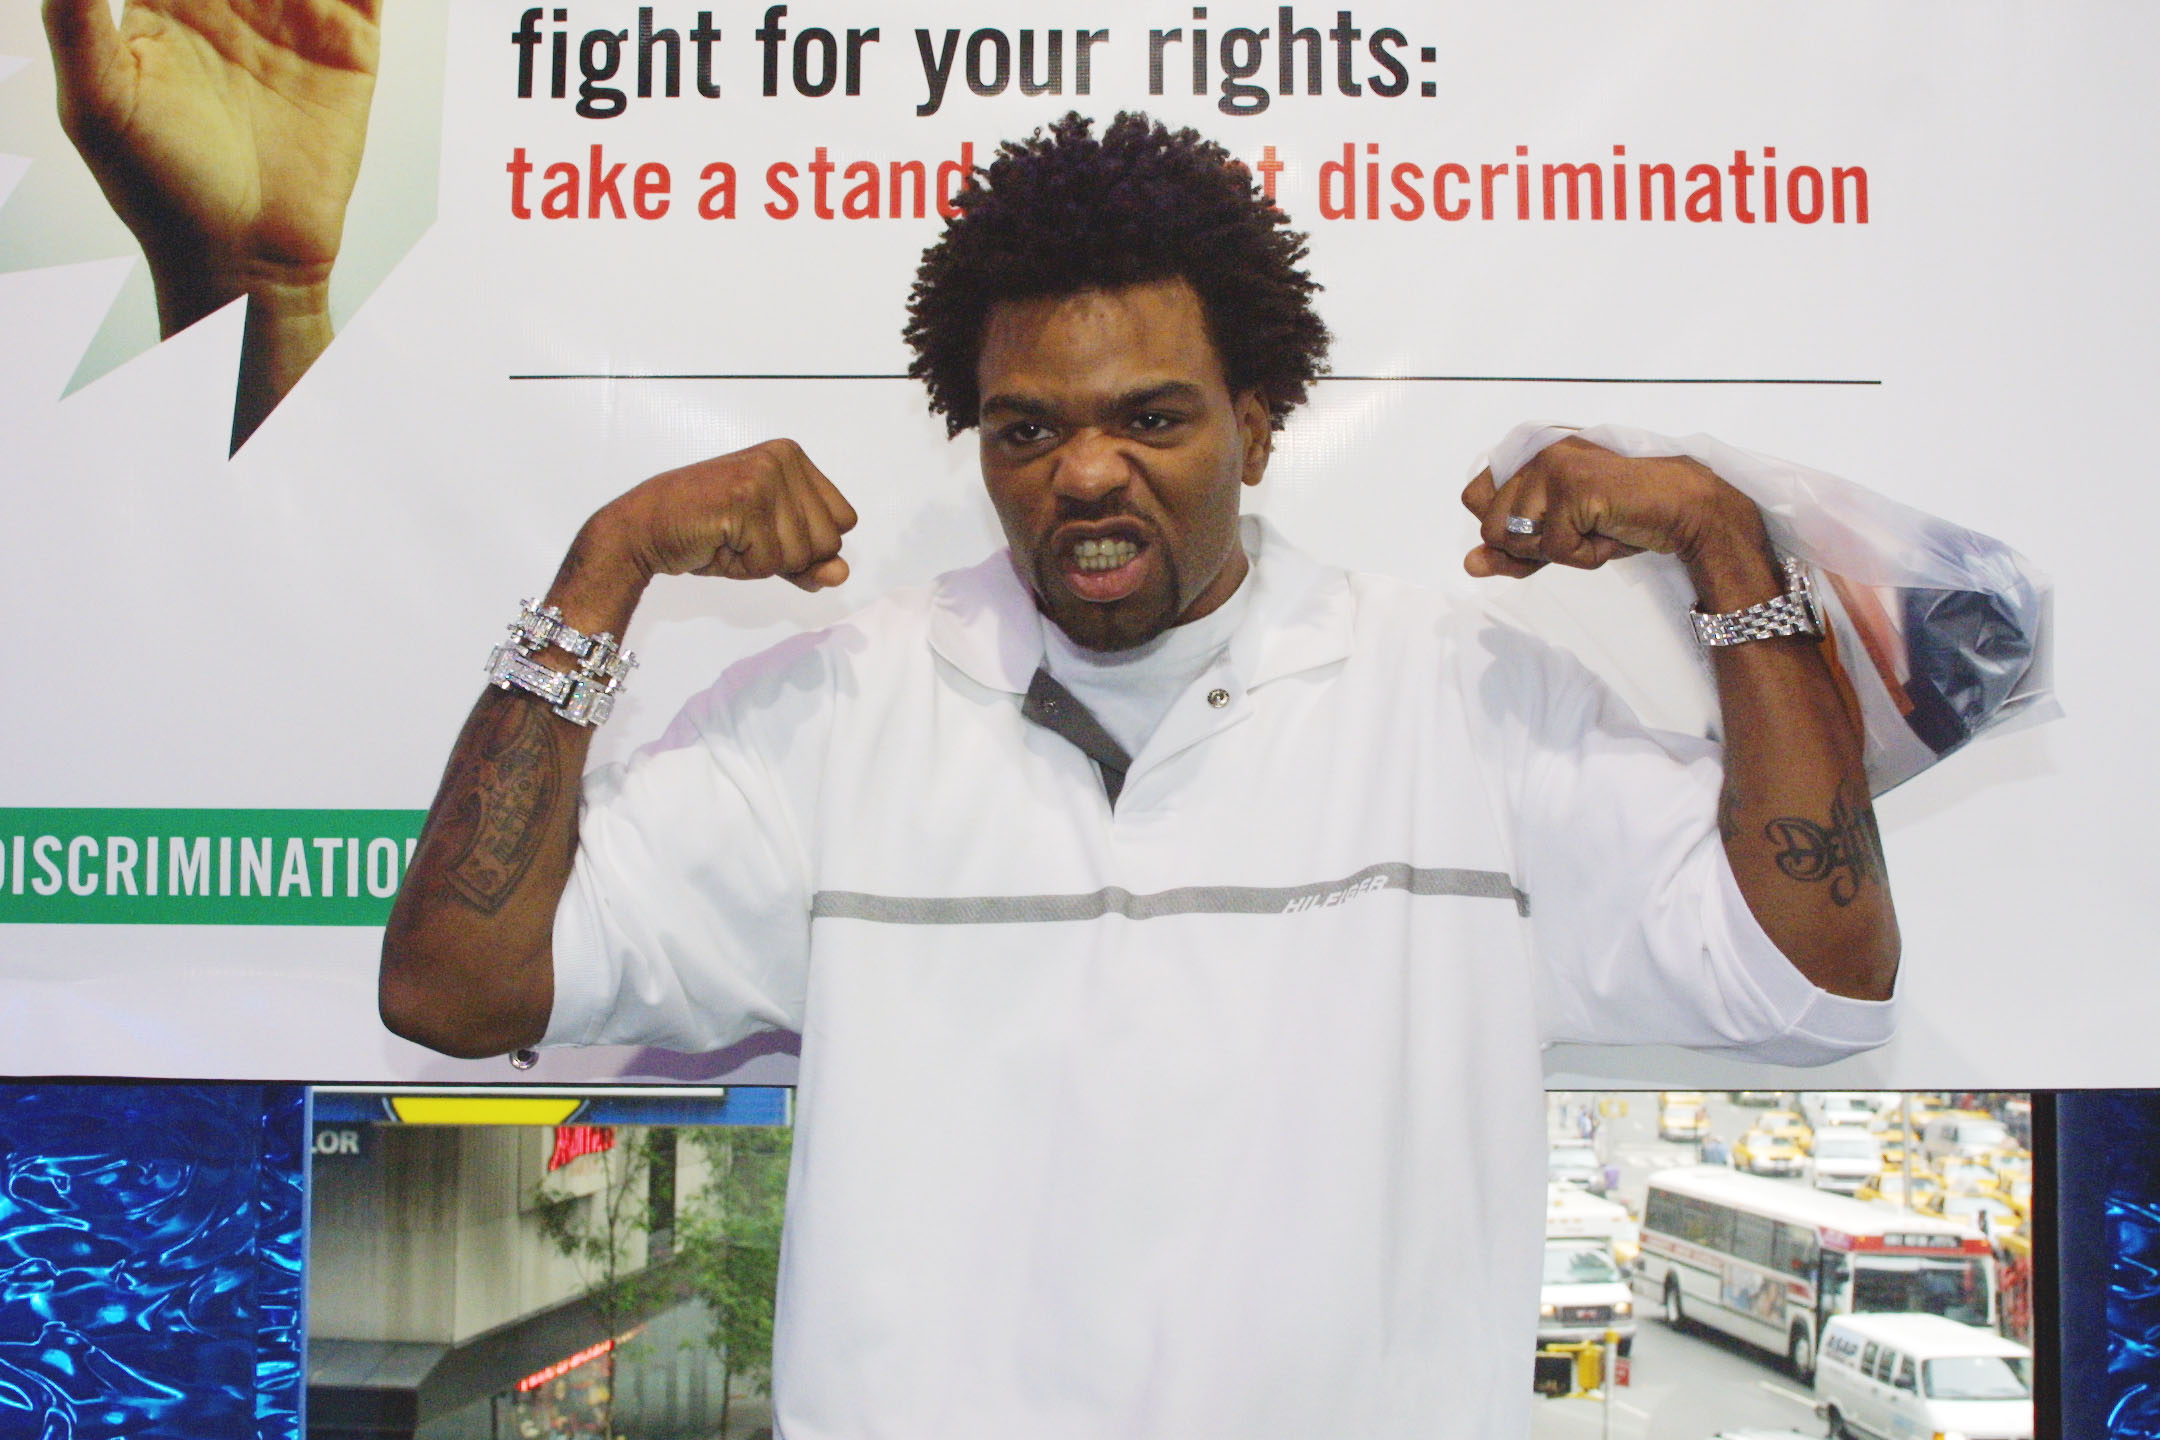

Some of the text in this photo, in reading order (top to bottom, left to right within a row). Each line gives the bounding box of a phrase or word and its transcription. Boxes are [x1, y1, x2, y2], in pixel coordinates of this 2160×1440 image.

[511, 5, 1438, 120] fight for your rights:
[506, 144, 672, 221] take
[697, 161, 738, 221] a
[764, 141, 974, 221] stand
[1318, 142, 1869, 225] discrimination
[0, 835, 418, 899] ISCRIMINATIO
